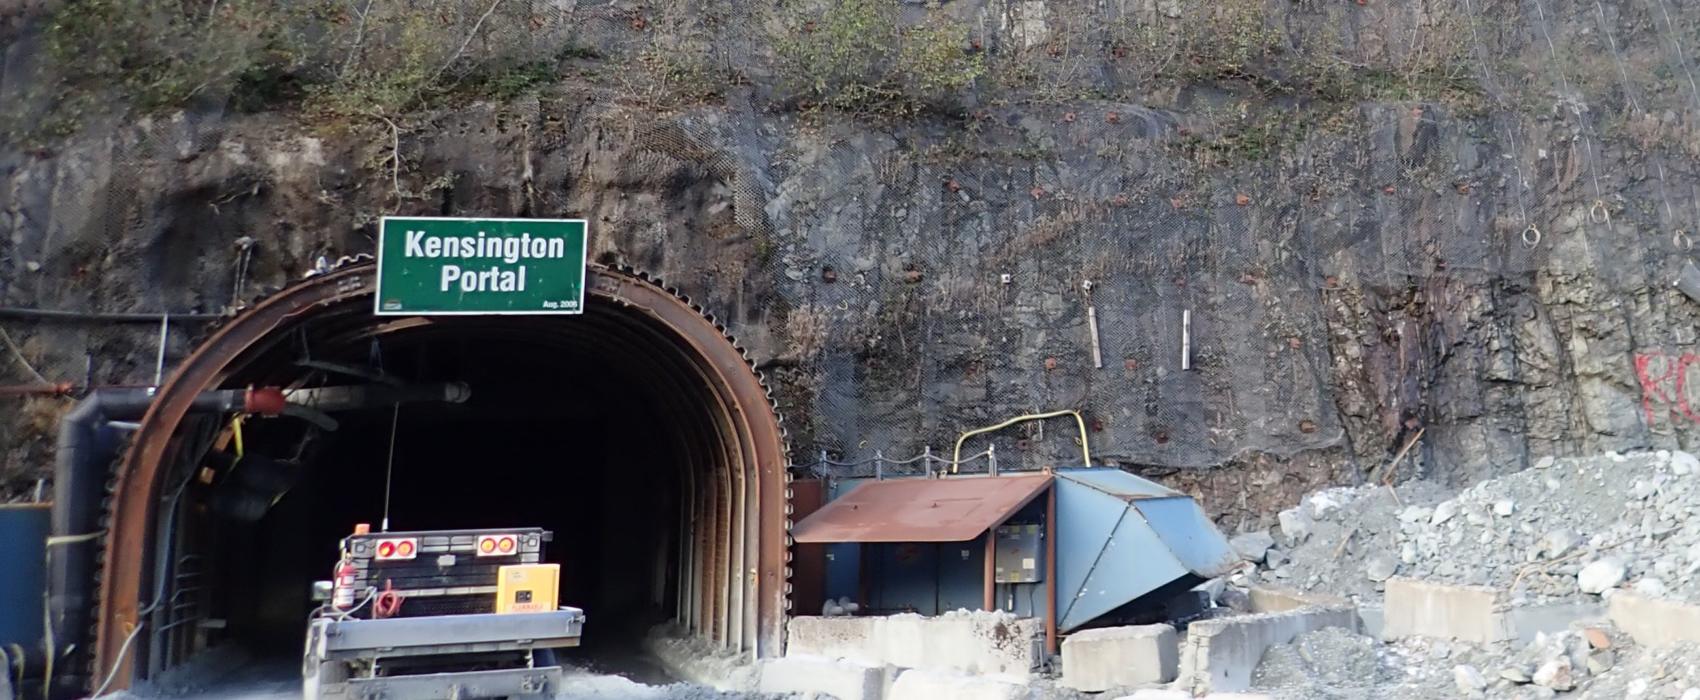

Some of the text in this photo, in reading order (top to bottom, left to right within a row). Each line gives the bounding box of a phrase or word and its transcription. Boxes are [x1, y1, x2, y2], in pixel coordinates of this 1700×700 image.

[404, 230, 565, 264] Kensington
[440, 264, 526, 293] Portal
[542, 300, 559, 309] Aug.
